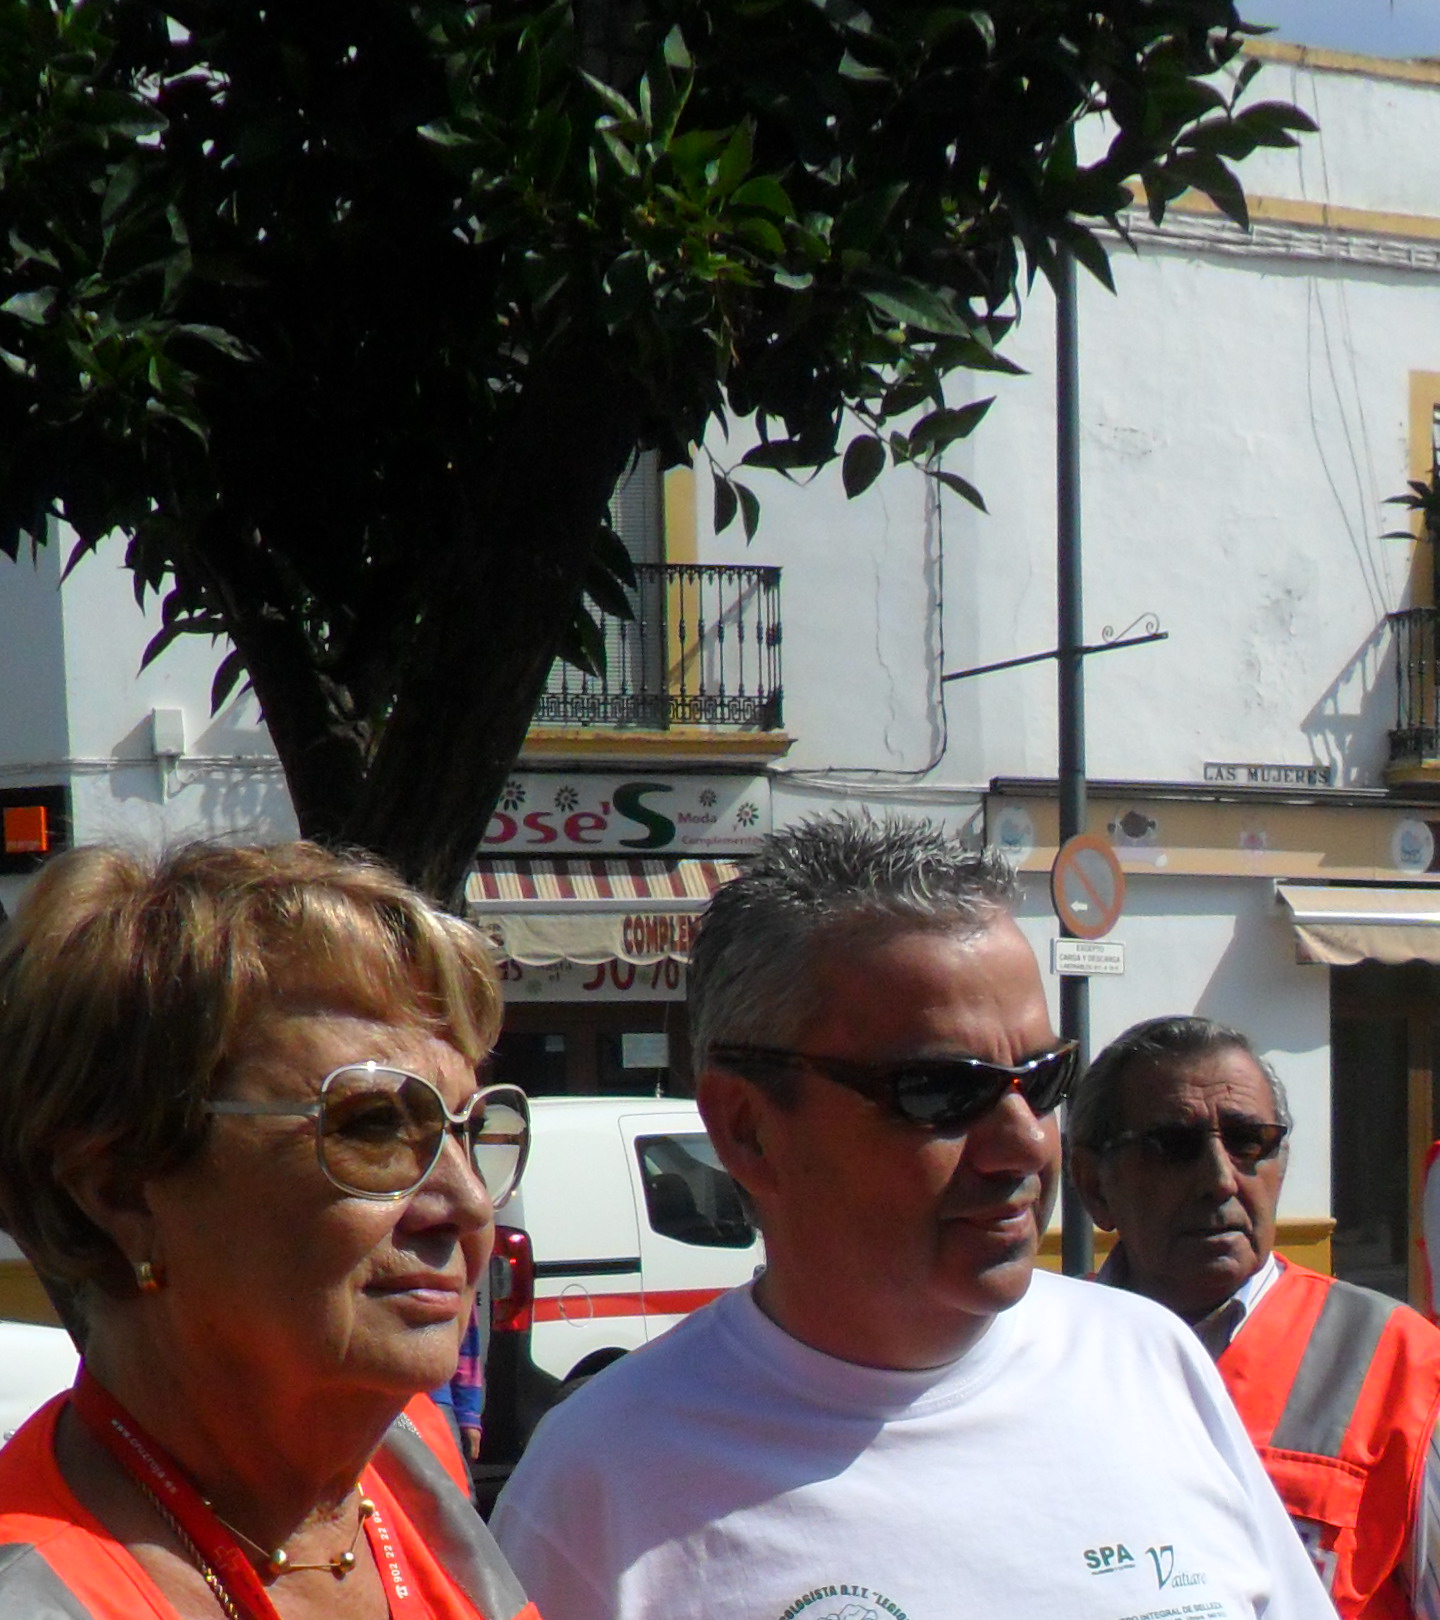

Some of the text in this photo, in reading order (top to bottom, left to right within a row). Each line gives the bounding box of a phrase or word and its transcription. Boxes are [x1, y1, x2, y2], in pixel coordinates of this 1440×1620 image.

[1203, 766, 1330, 785] LAS MUJERES
[677, 812, 718, 824] Moda
[1083, 1543, 1135, 1570] SPA
[1182, 1604, 1193, 1613] DE
